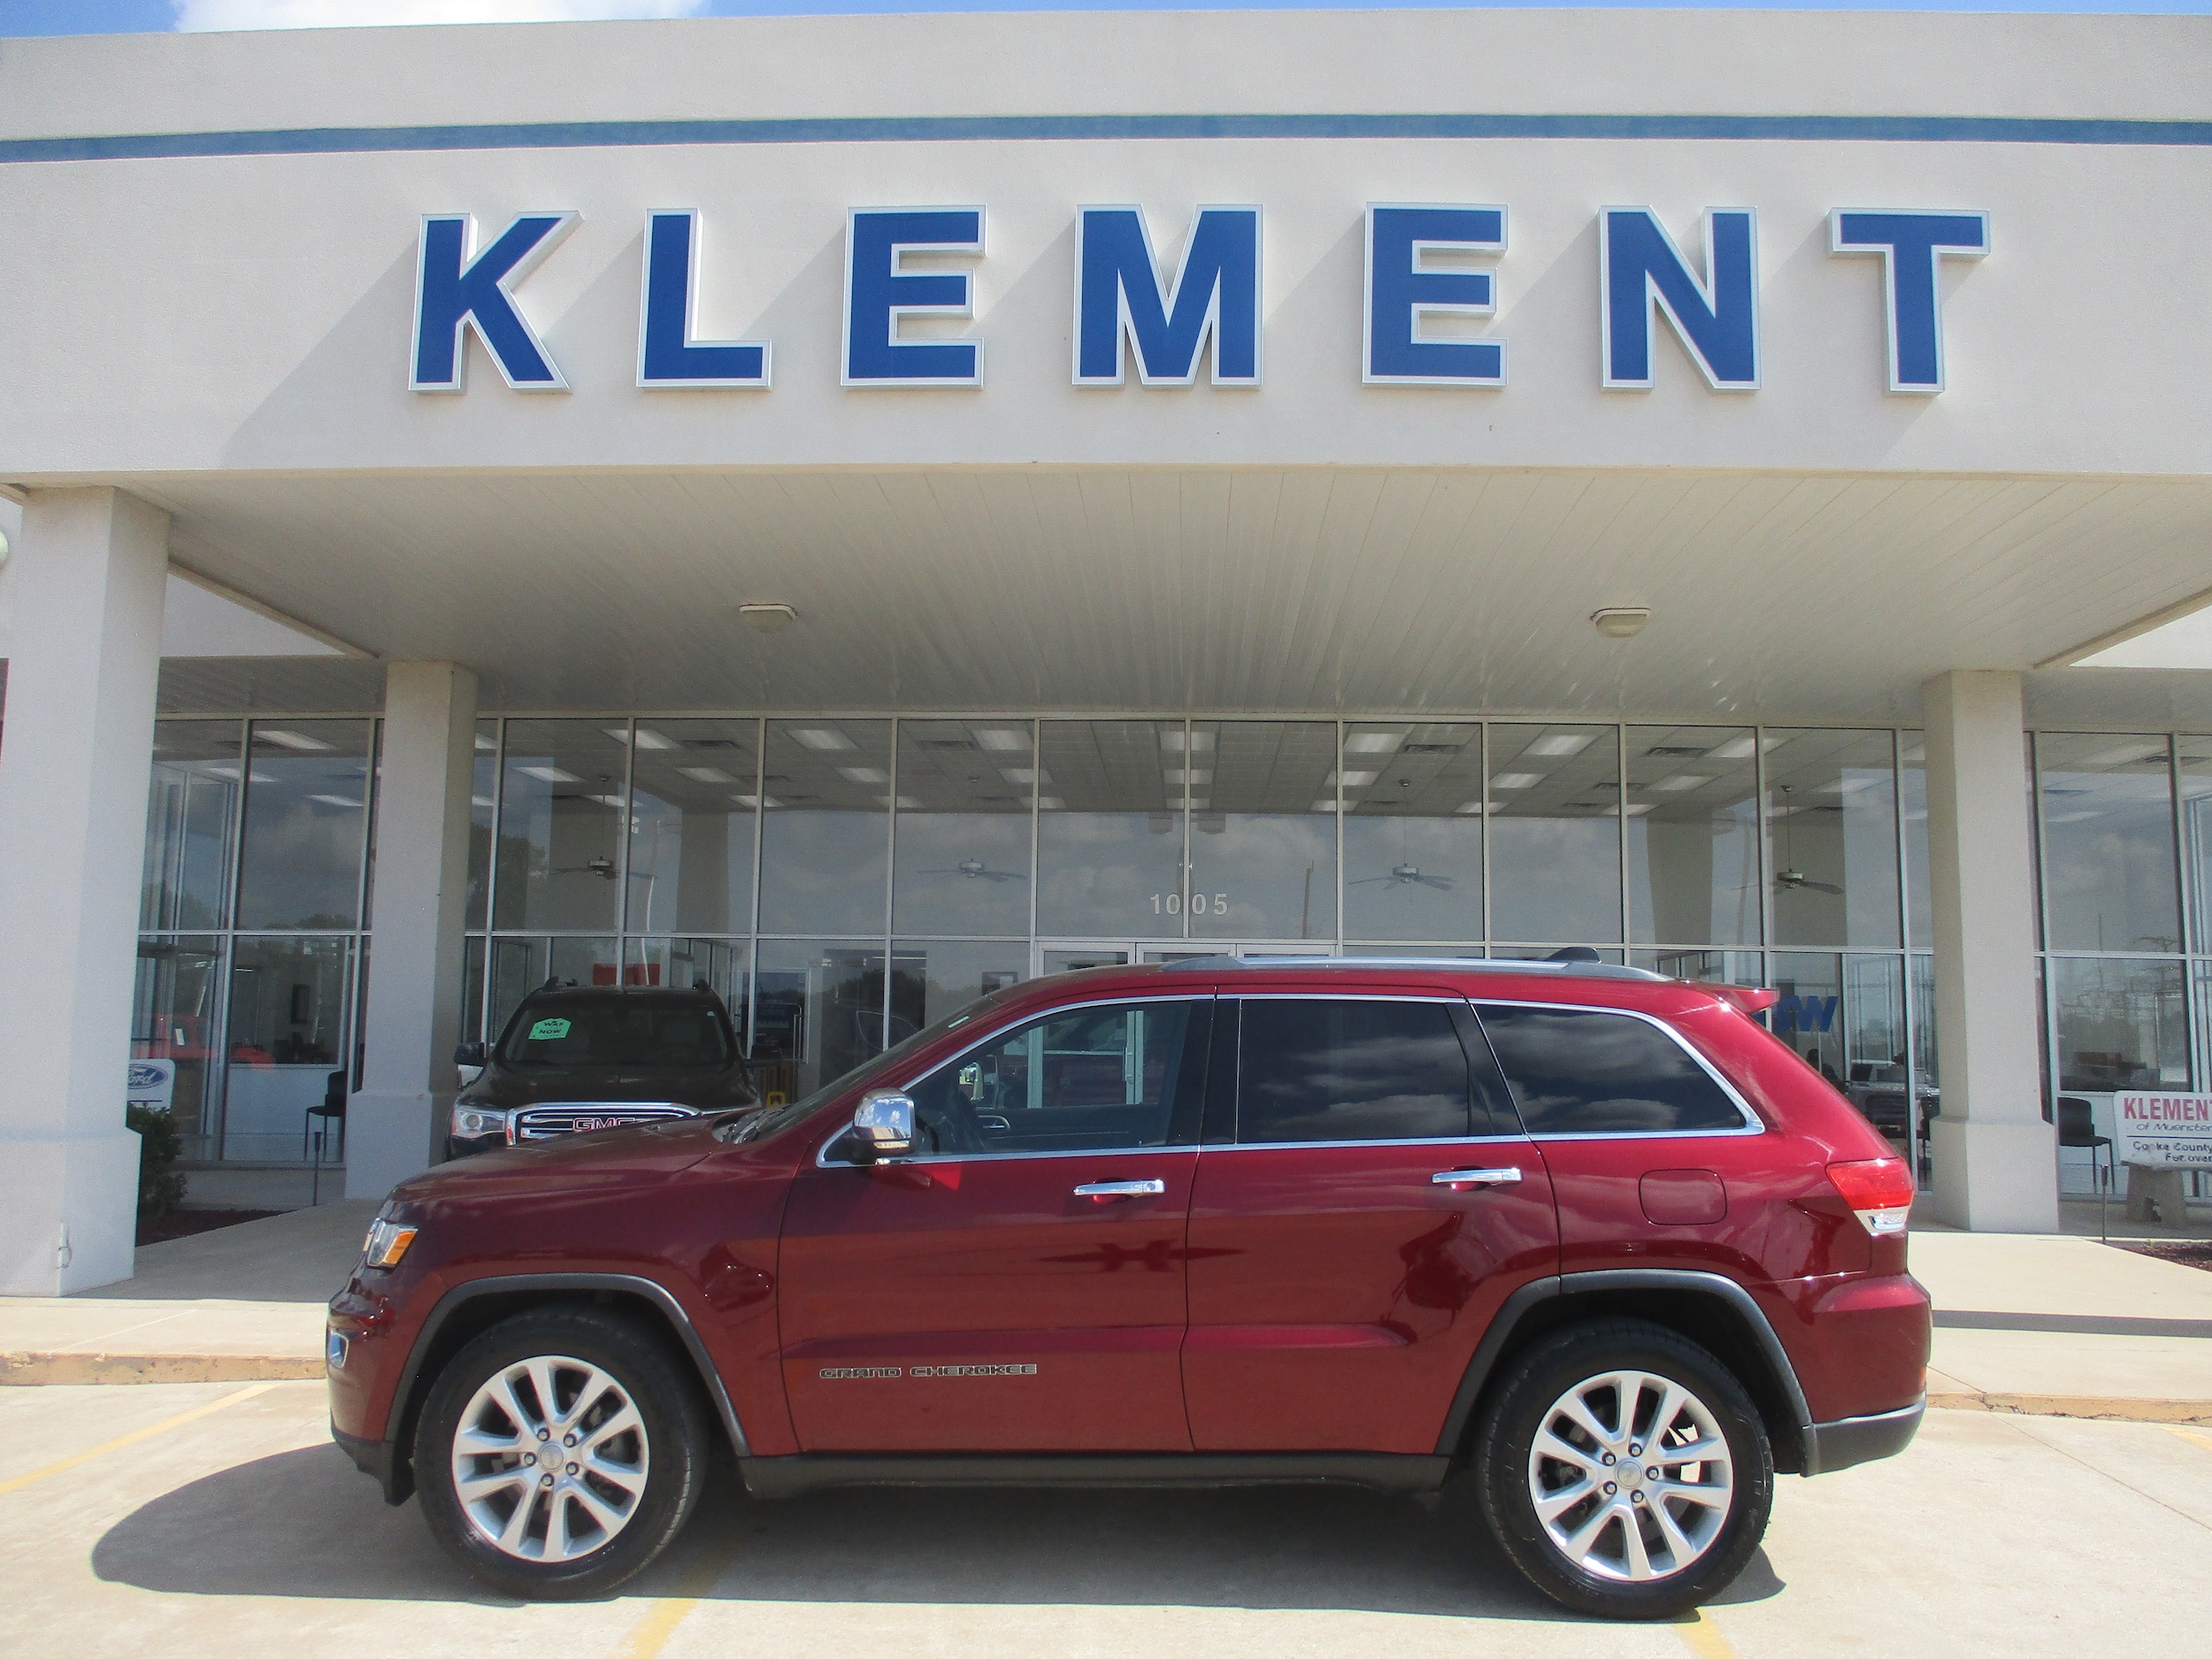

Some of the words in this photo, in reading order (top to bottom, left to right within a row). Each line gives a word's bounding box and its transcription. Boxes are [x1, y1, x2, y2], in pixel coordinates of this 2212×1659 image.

[408, 201, 1992, 396] KLEMENT
[1150, 893, 1227, 916] 1005
[2124, 1097, 2212, 1121] KLEMEN
[2132, 1141, 2170, 1151] Coke
[2173, 1142, 2212, 1154] County
[819, 1367, 902, 1379] GRAND
[910, 1363, 1038, 1377] CHEROKEE
